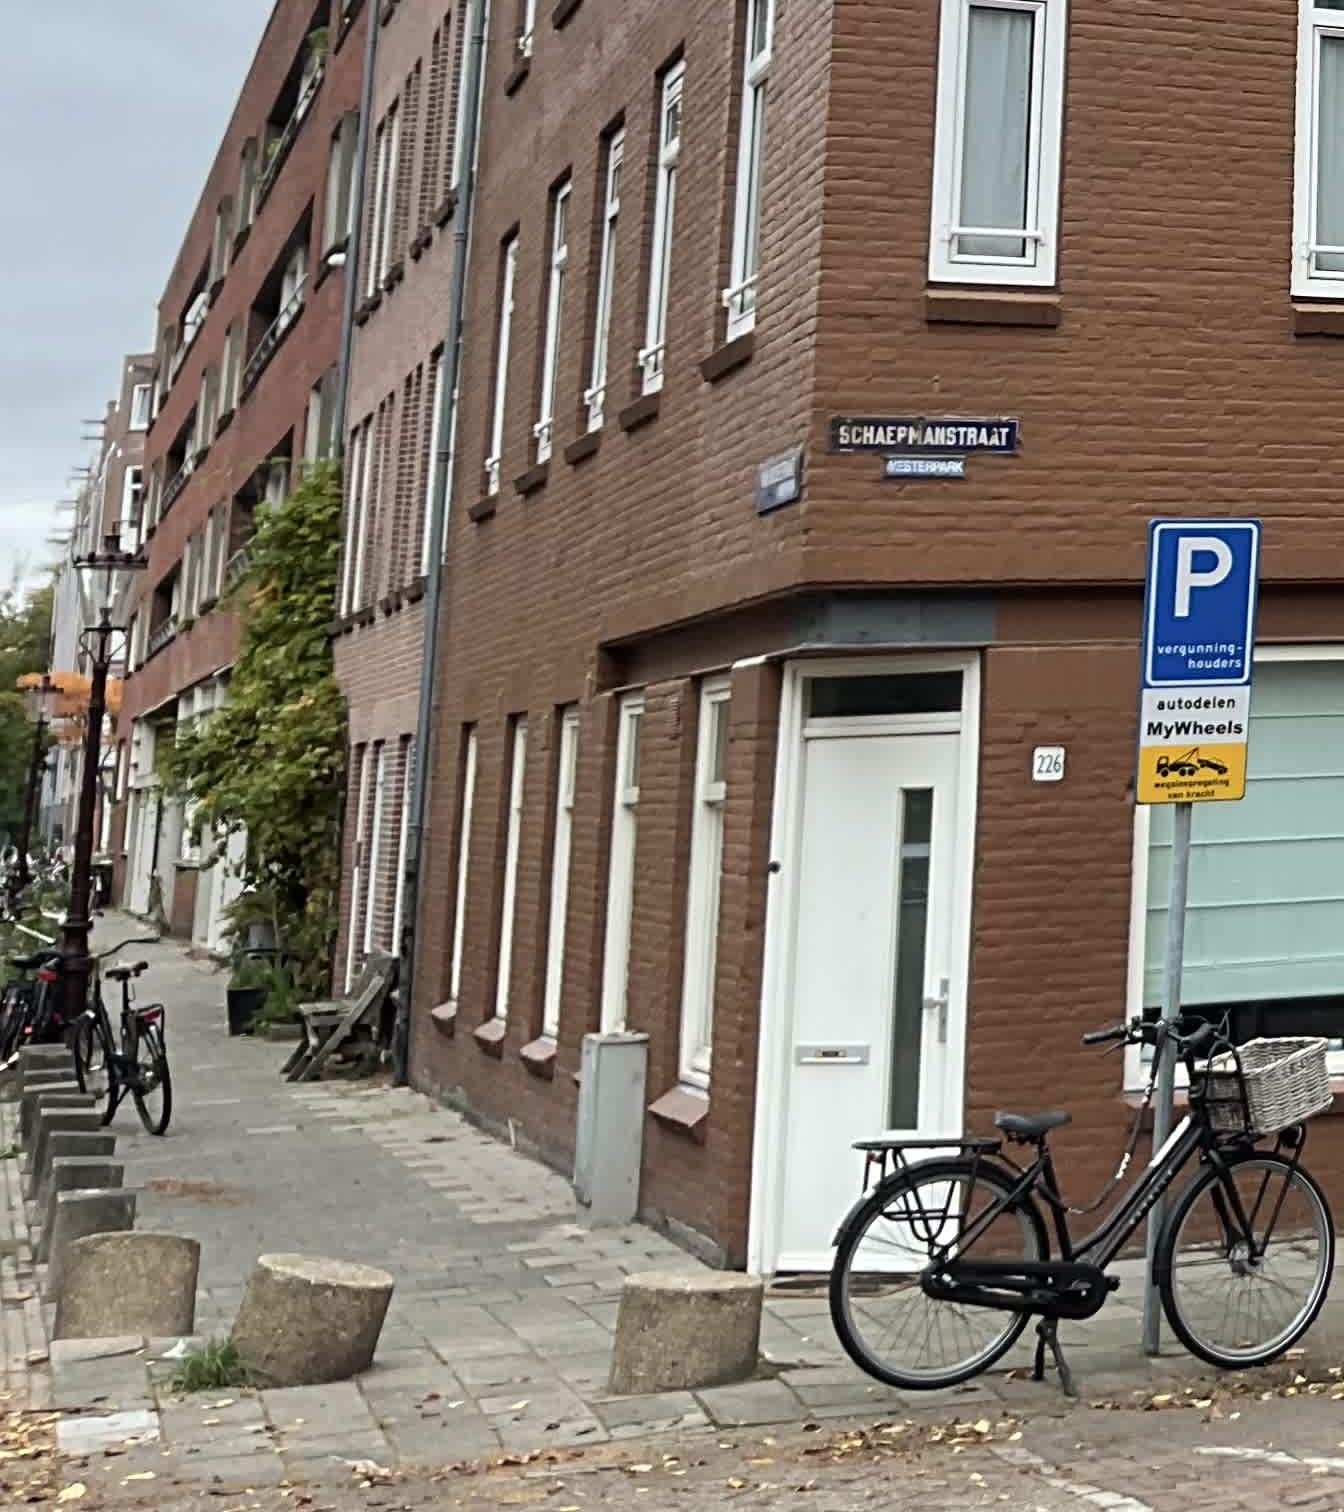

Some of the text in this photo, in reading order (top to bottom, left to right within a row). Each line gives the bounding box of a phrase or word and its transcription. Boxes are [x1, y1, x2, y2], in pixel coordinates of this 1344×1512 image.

[839, 425, 1010, 446] SCHAEPMANSTRAAT
[1173, 536, 1233, 617] P
[1156, 642, 1244, 657] vergunning-
[1187, 655, 1242, 670] houders
[1156, 696, 1236, 711] autodelen
[1146, 719, 1243, 739] MyWheels
[1037, 753, 1062, 774] 226
